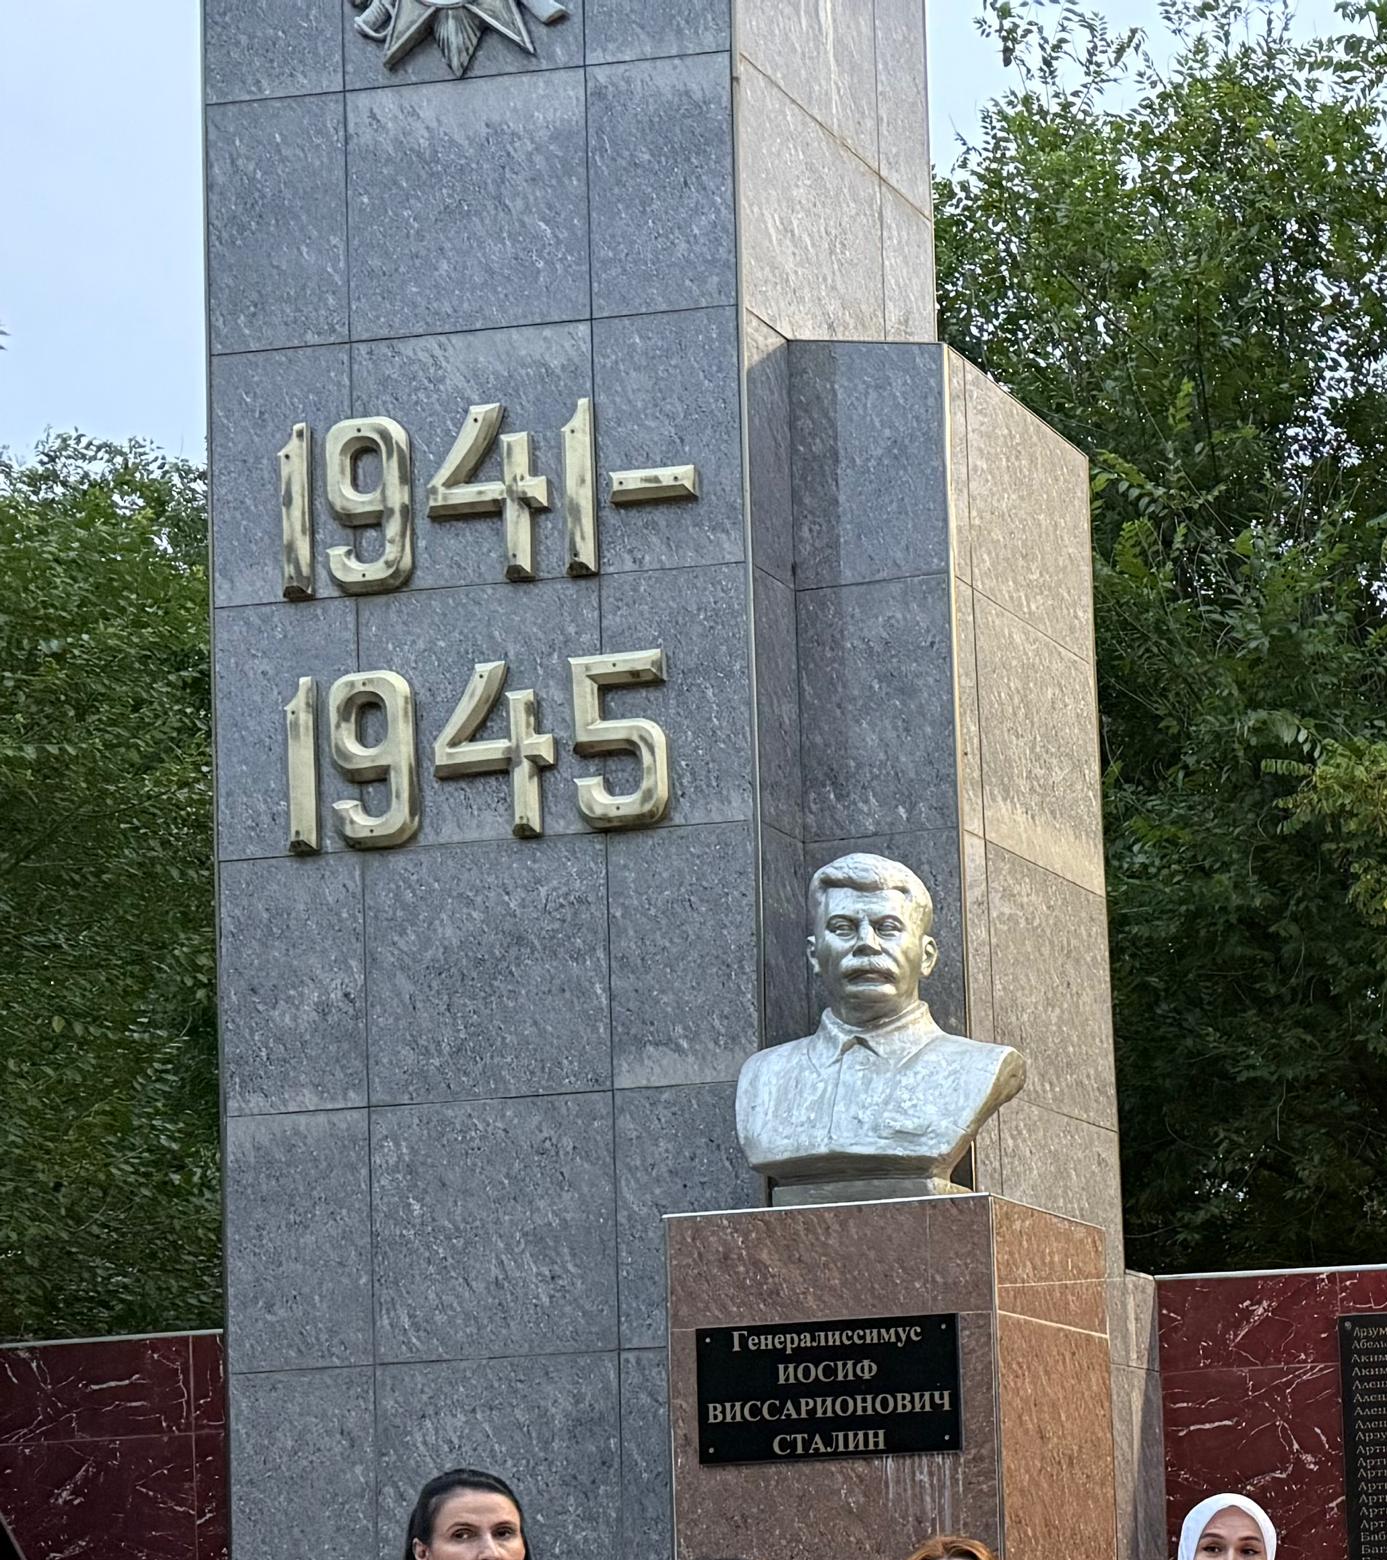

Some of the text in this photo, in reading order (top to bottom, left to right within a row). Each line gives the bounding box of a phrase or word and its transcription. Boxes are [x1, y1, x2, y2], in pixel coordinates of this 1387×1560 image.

[283, 648, 671, 855] 1945
[732, 1326, 922, 1354] Генералиссимус
[777, 1360, 878, 1384] ИОСИФ
[707, 1391, 952, 1423] ВИССАРИОНОВИЧ
[773, 1430, 886, 1455] СТАЛИН
